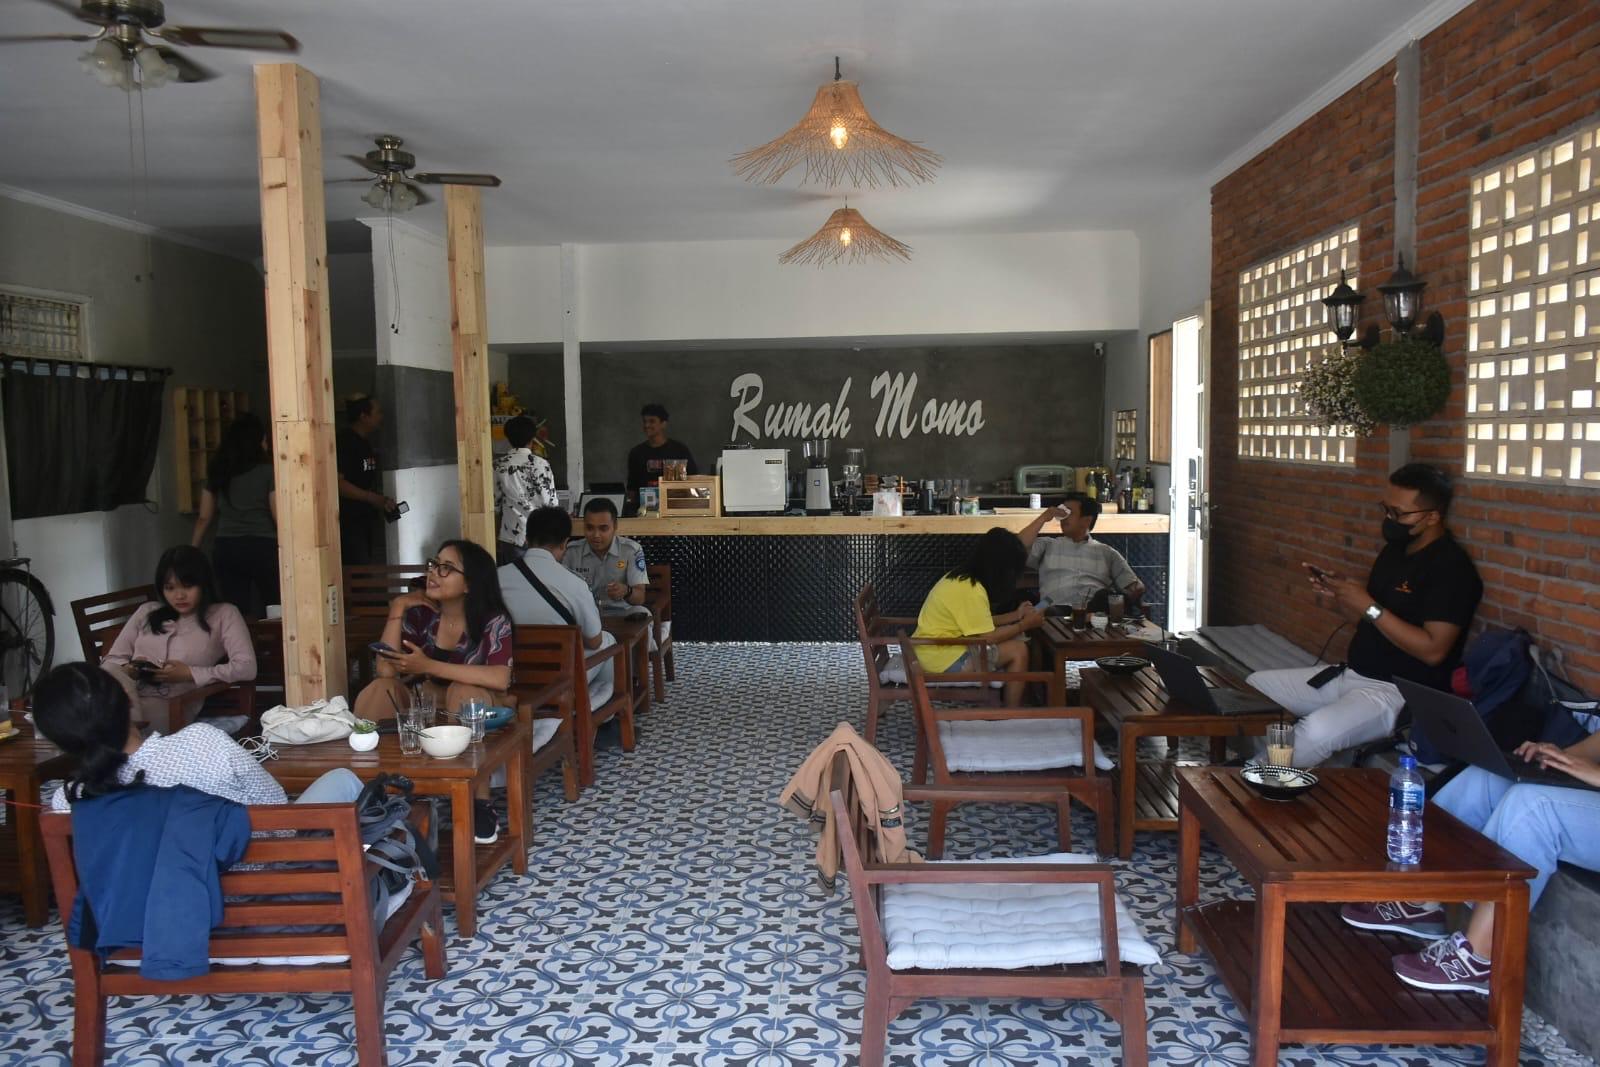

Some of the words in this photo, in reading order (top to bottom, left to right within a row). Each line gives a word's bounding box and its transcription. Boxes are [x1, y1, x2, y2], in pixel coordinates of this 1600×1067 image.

[731, 373, 852, 442] Rumah
[871, 370, 986, 439] Momo
[1376, 901, 1401, 921] N
[1439, 958, 1471, 982] N
